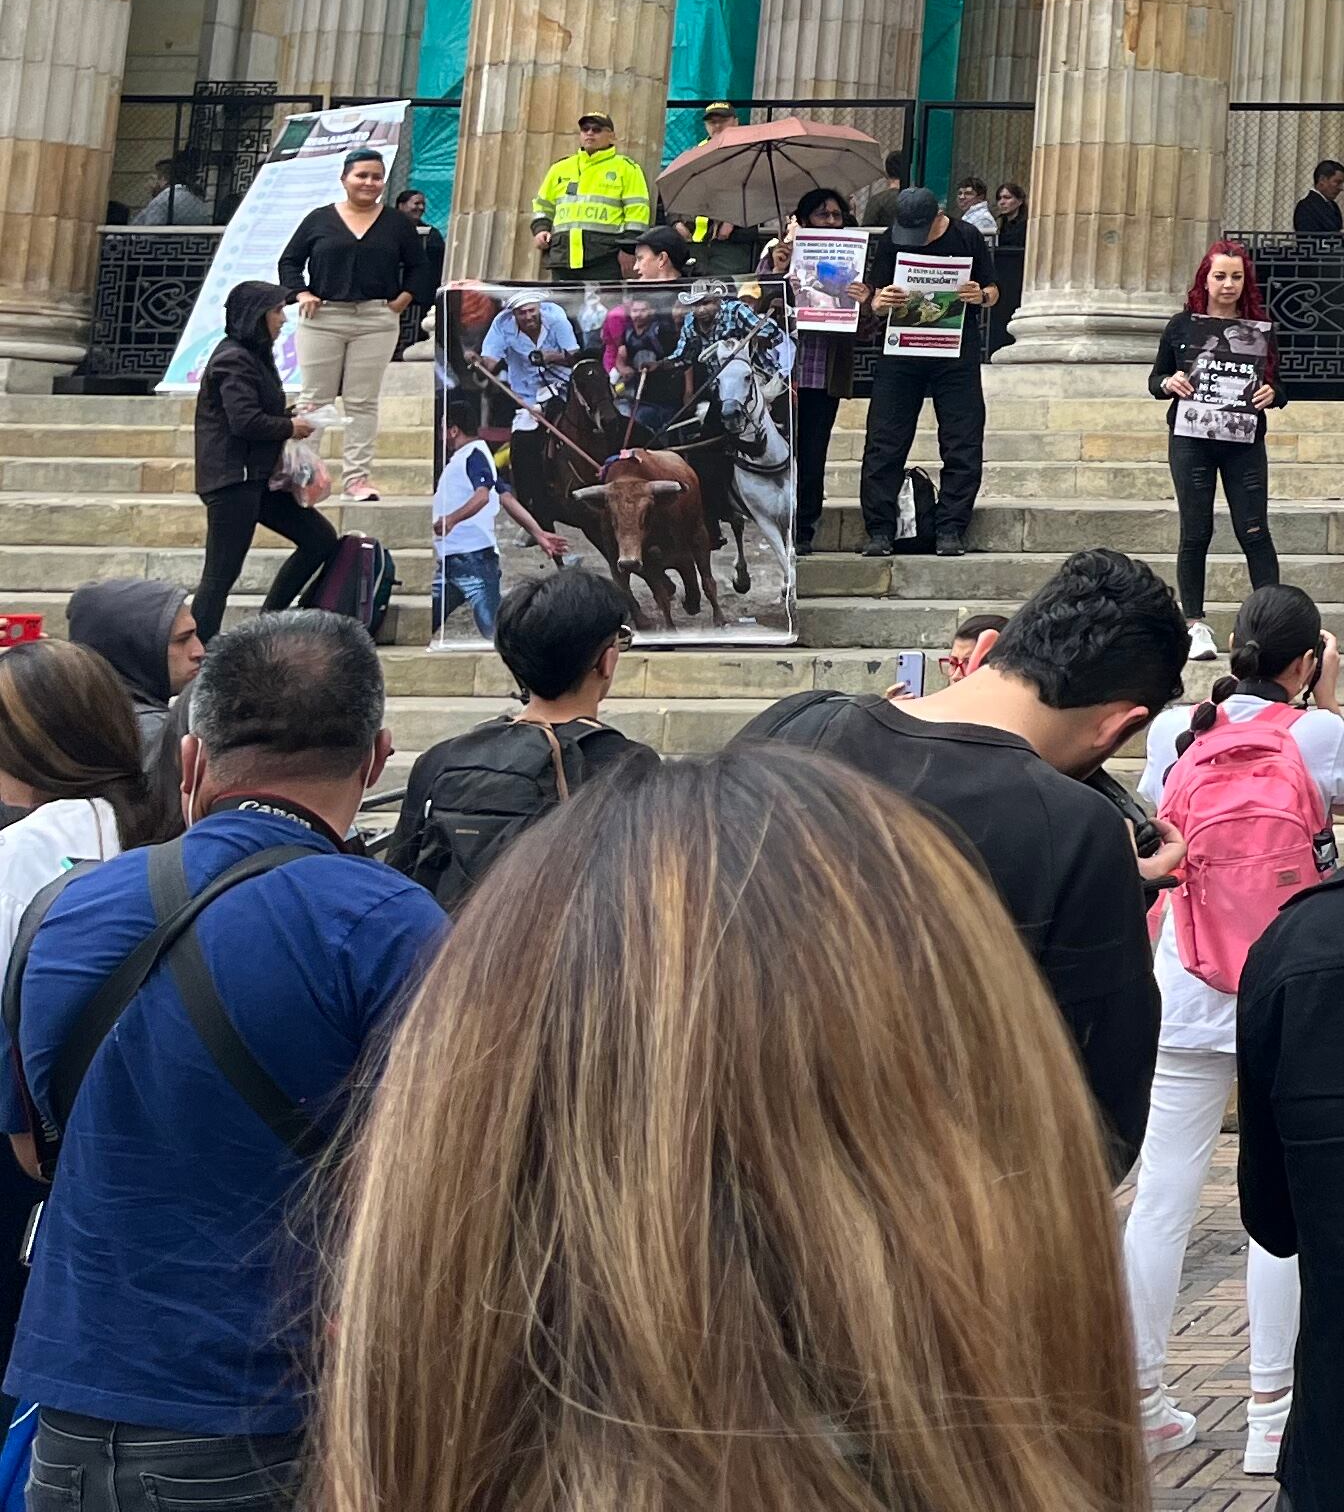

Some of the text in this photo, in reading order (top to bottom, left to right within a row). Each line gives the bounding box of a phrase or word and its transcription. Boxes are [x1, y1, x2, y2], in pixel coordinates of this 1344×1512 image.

[1197, 359, 1254, 374] SI AL PL 85
